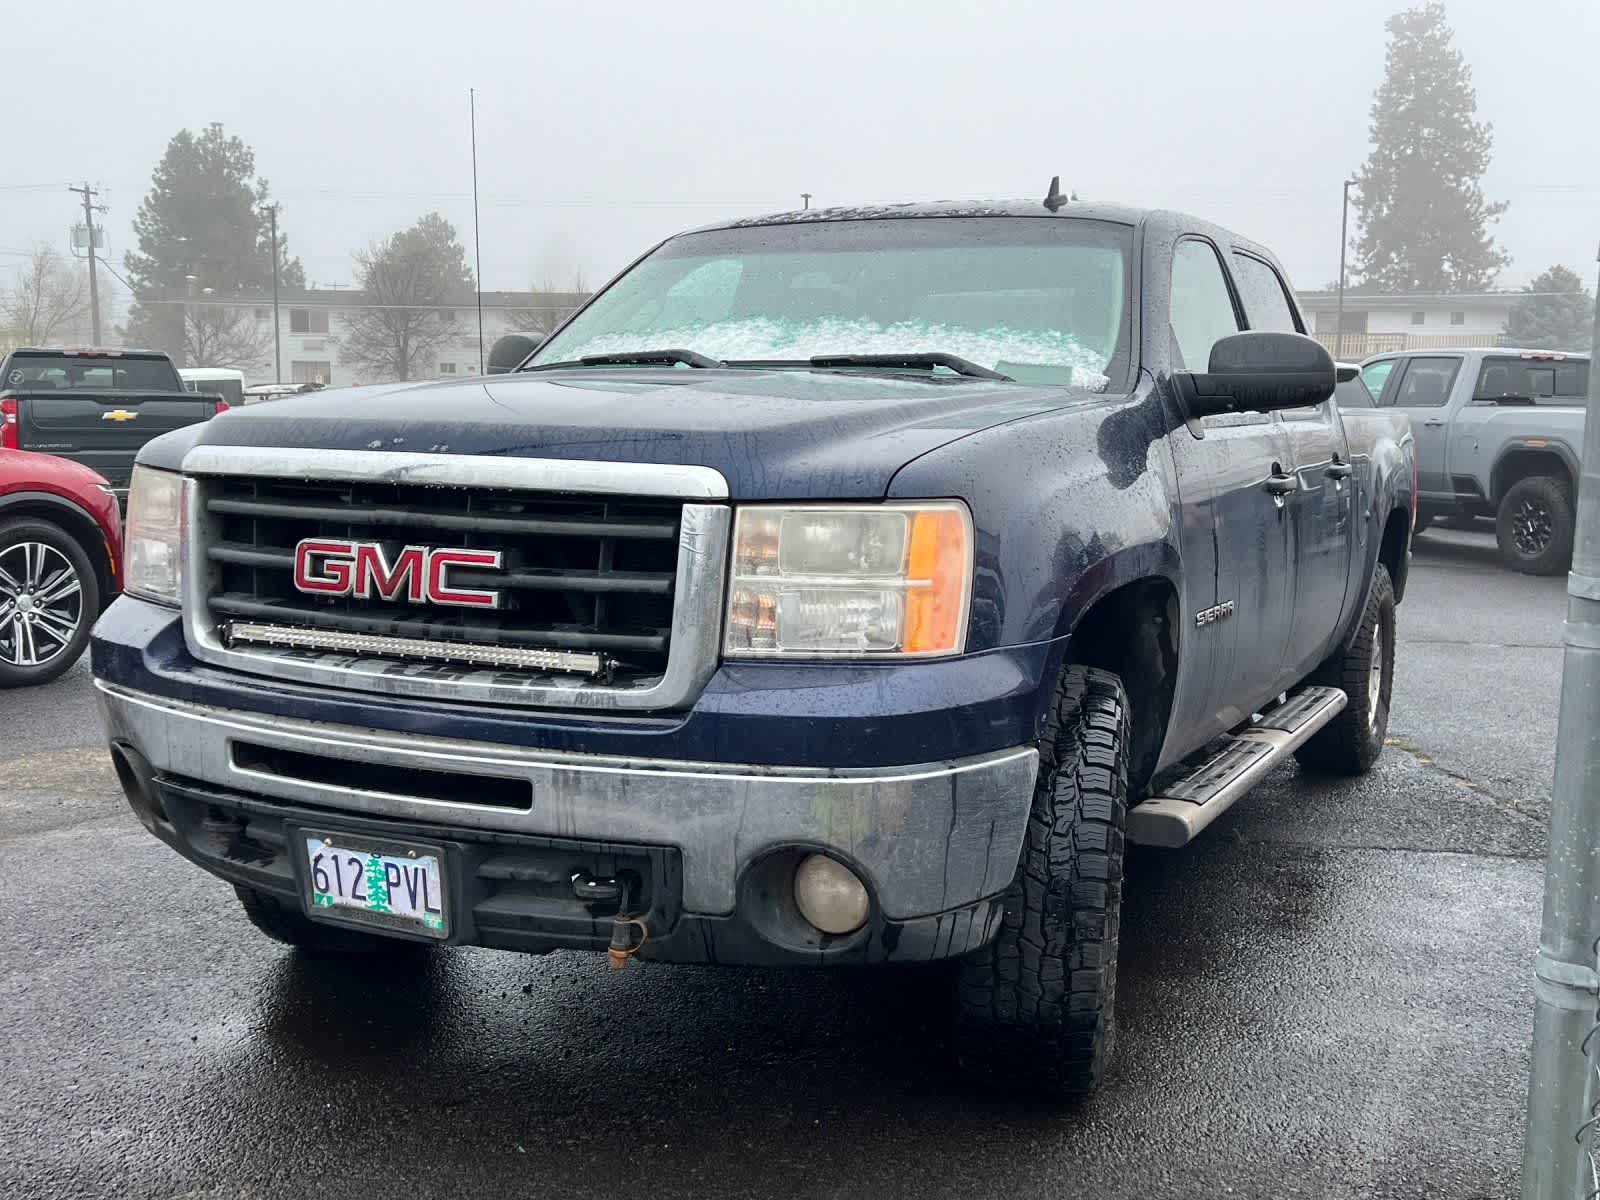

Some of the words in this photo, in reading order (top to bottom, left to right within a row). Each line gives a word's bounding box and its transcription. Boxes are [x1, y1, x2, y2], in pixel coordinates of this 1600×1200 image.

[295, 538, 501, 609] GMC
[313, 853, 367, 901] 612
[384, 861, 441, 914] PVL
